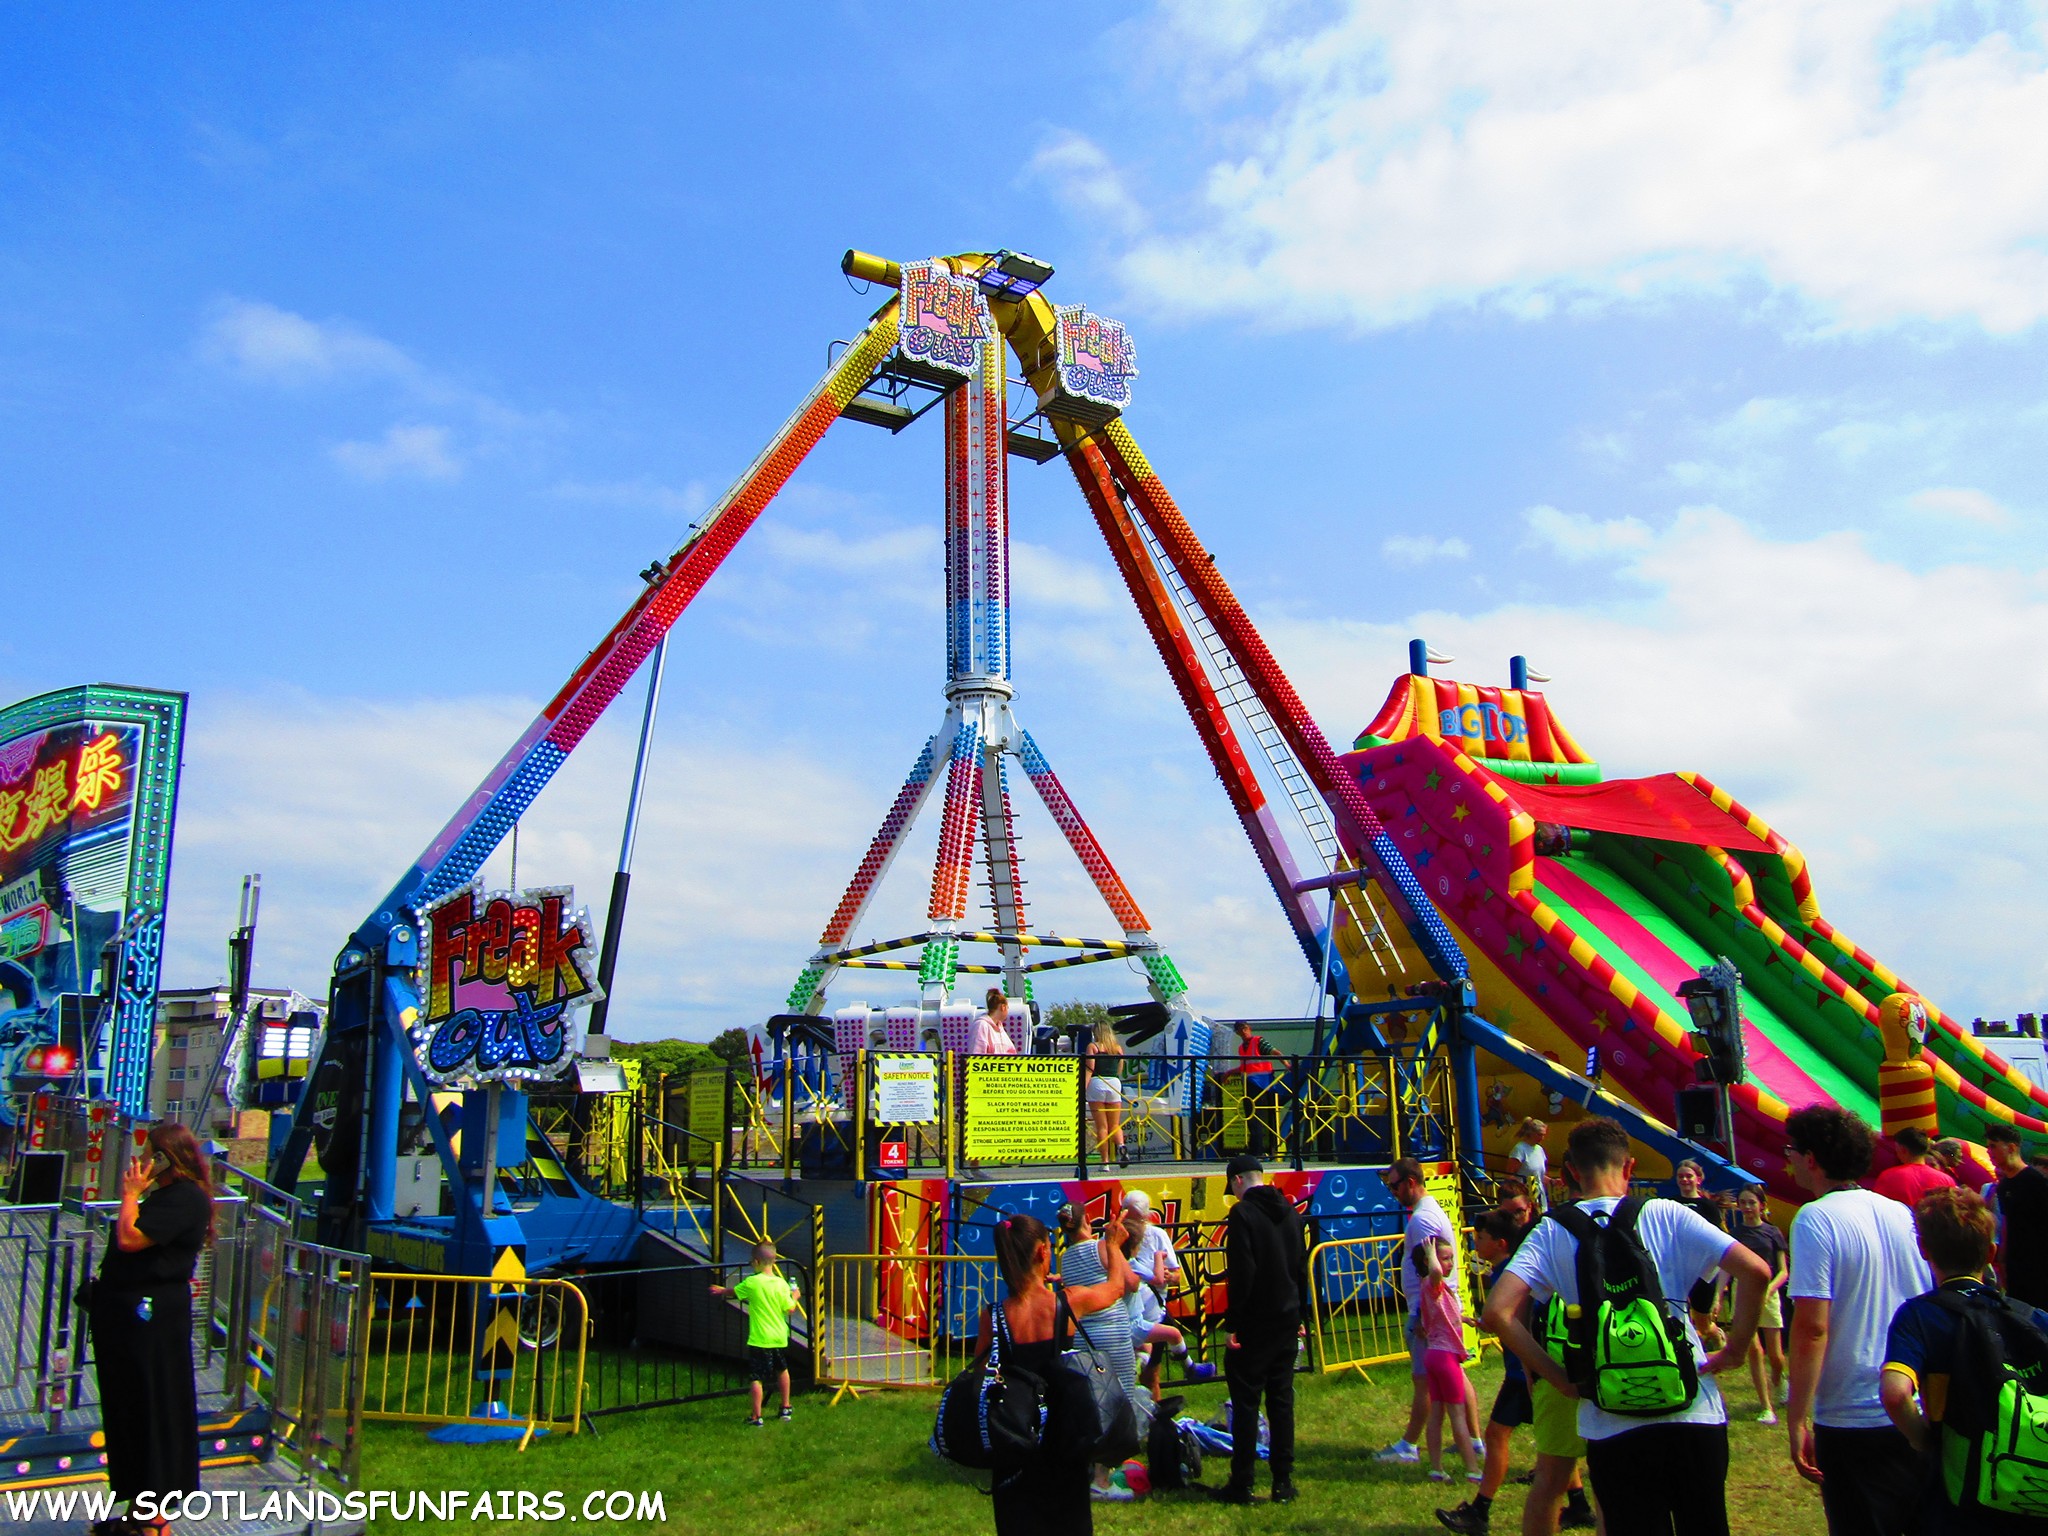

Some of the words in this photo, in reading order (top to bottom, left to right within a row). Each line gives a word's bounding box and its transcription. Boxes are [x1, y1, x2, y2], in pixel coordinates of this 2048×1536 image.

[904, 267, 985, 338] Freak
[1061, 312, 1135, 377] Freak
[1439, 703, 1481, 739] BIG
[1478, 702, 1528, 743] TOP
[428, 893, 587, 1021] Freak
[972, 1062, 1022, 1072] SAFETY
[1027, 1063, 1074, 1072] NOTICE
[888, 1144, 900, 1158] 4
